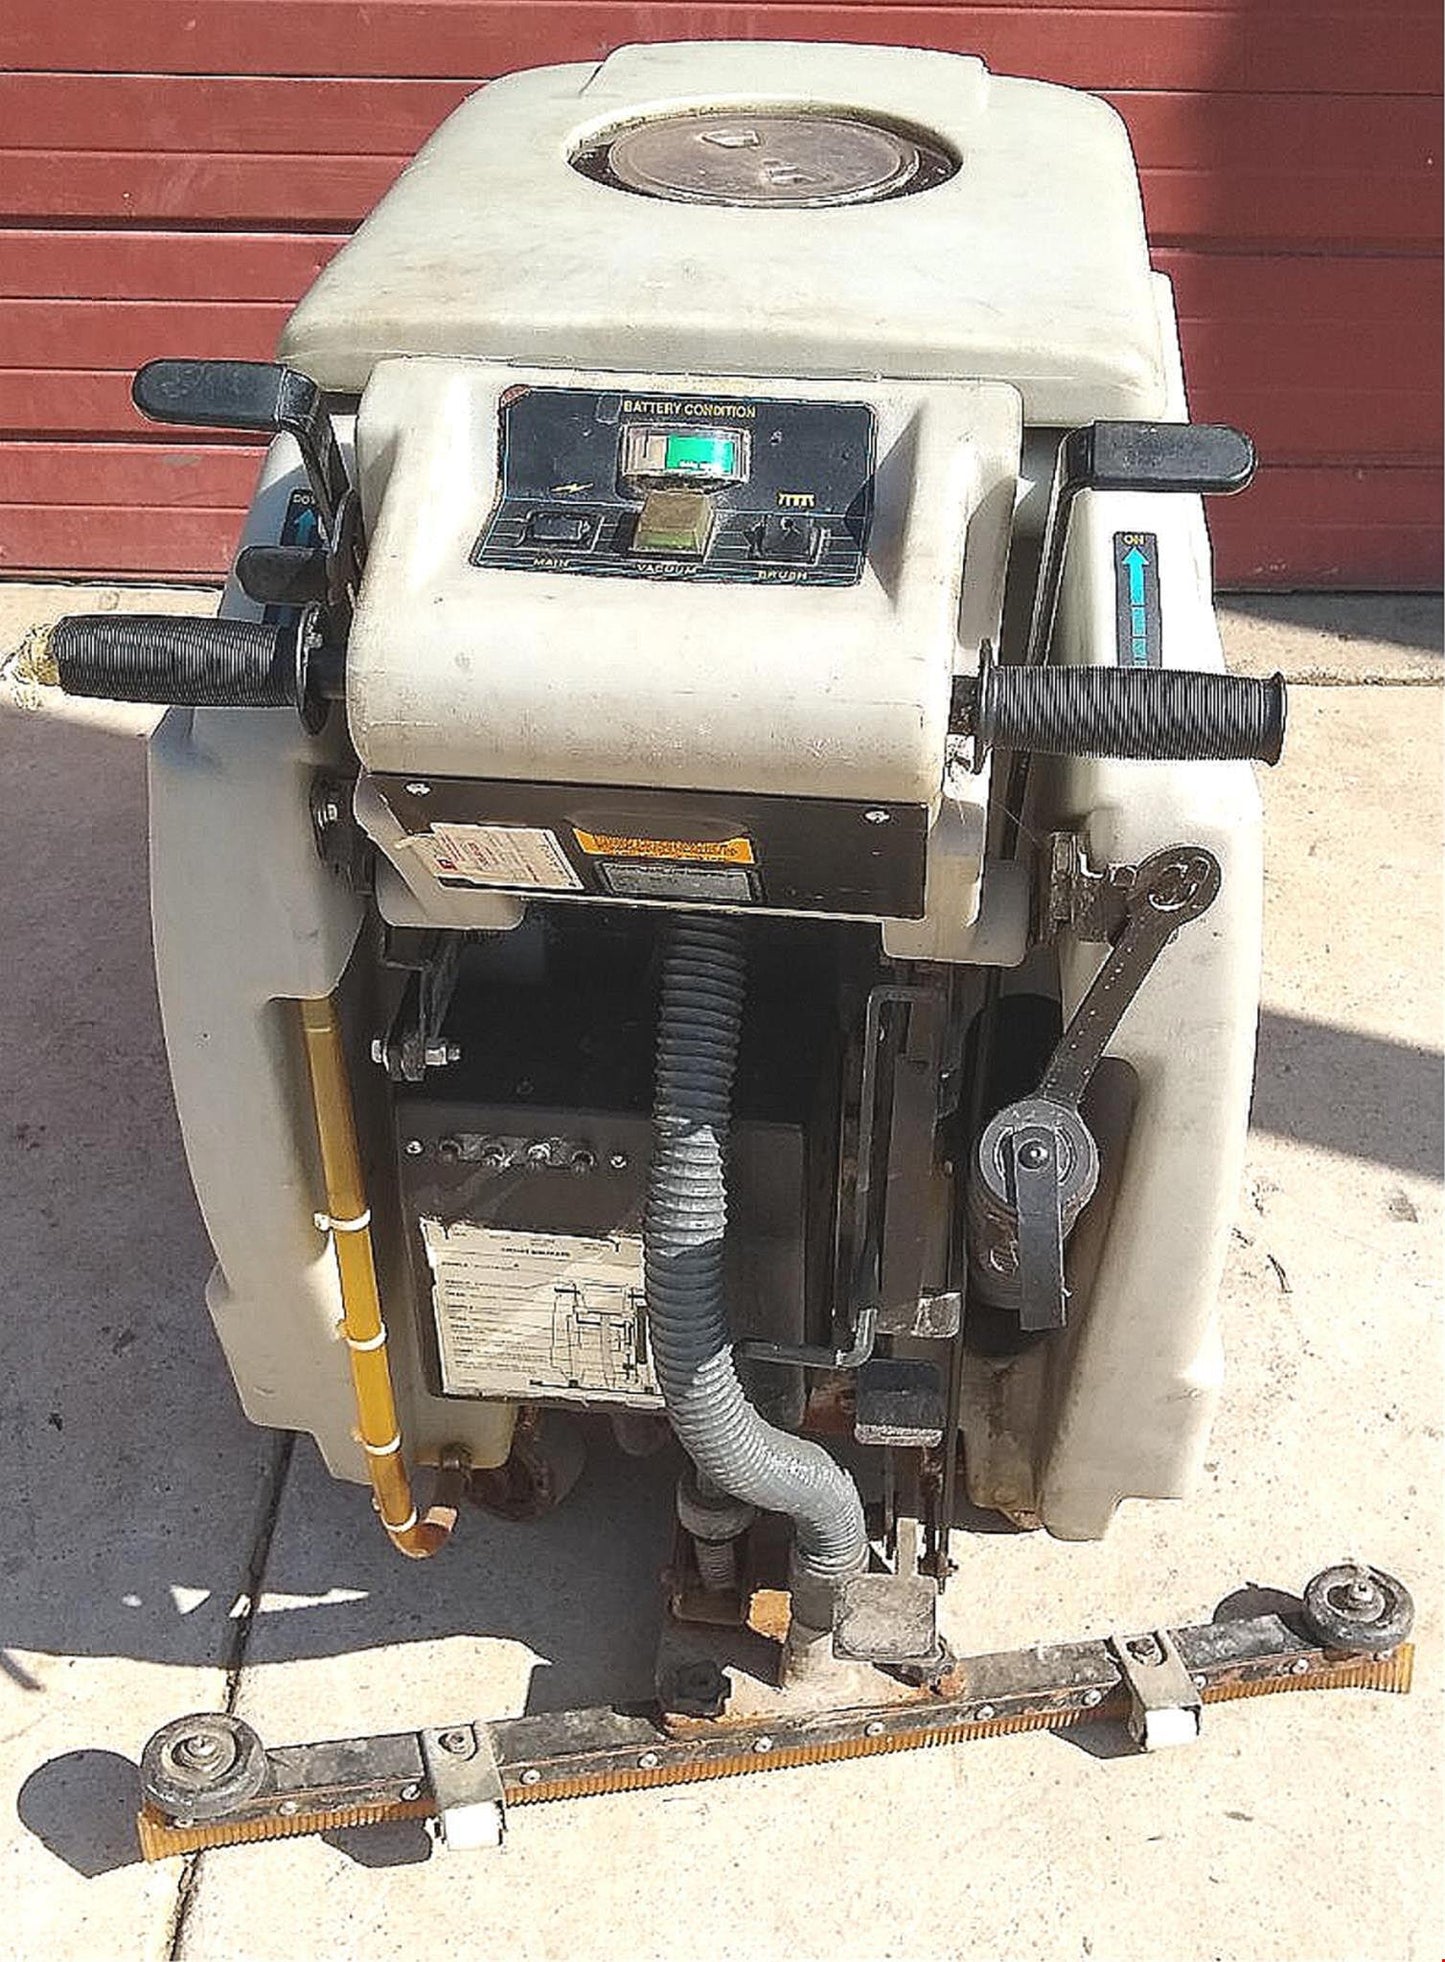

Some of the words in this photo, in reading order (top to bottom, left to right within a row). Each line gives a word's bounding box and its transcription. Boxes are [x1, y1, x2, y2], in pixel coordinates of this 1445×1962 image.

[623, 400, 682, 415] BATTERY
[684, 403, 756, 418] CONDITION
[1124, 534, 1145, 546] ON
[533, 558, 569, 567] MAIN
[636, 563, 699, 575] VACUUM
